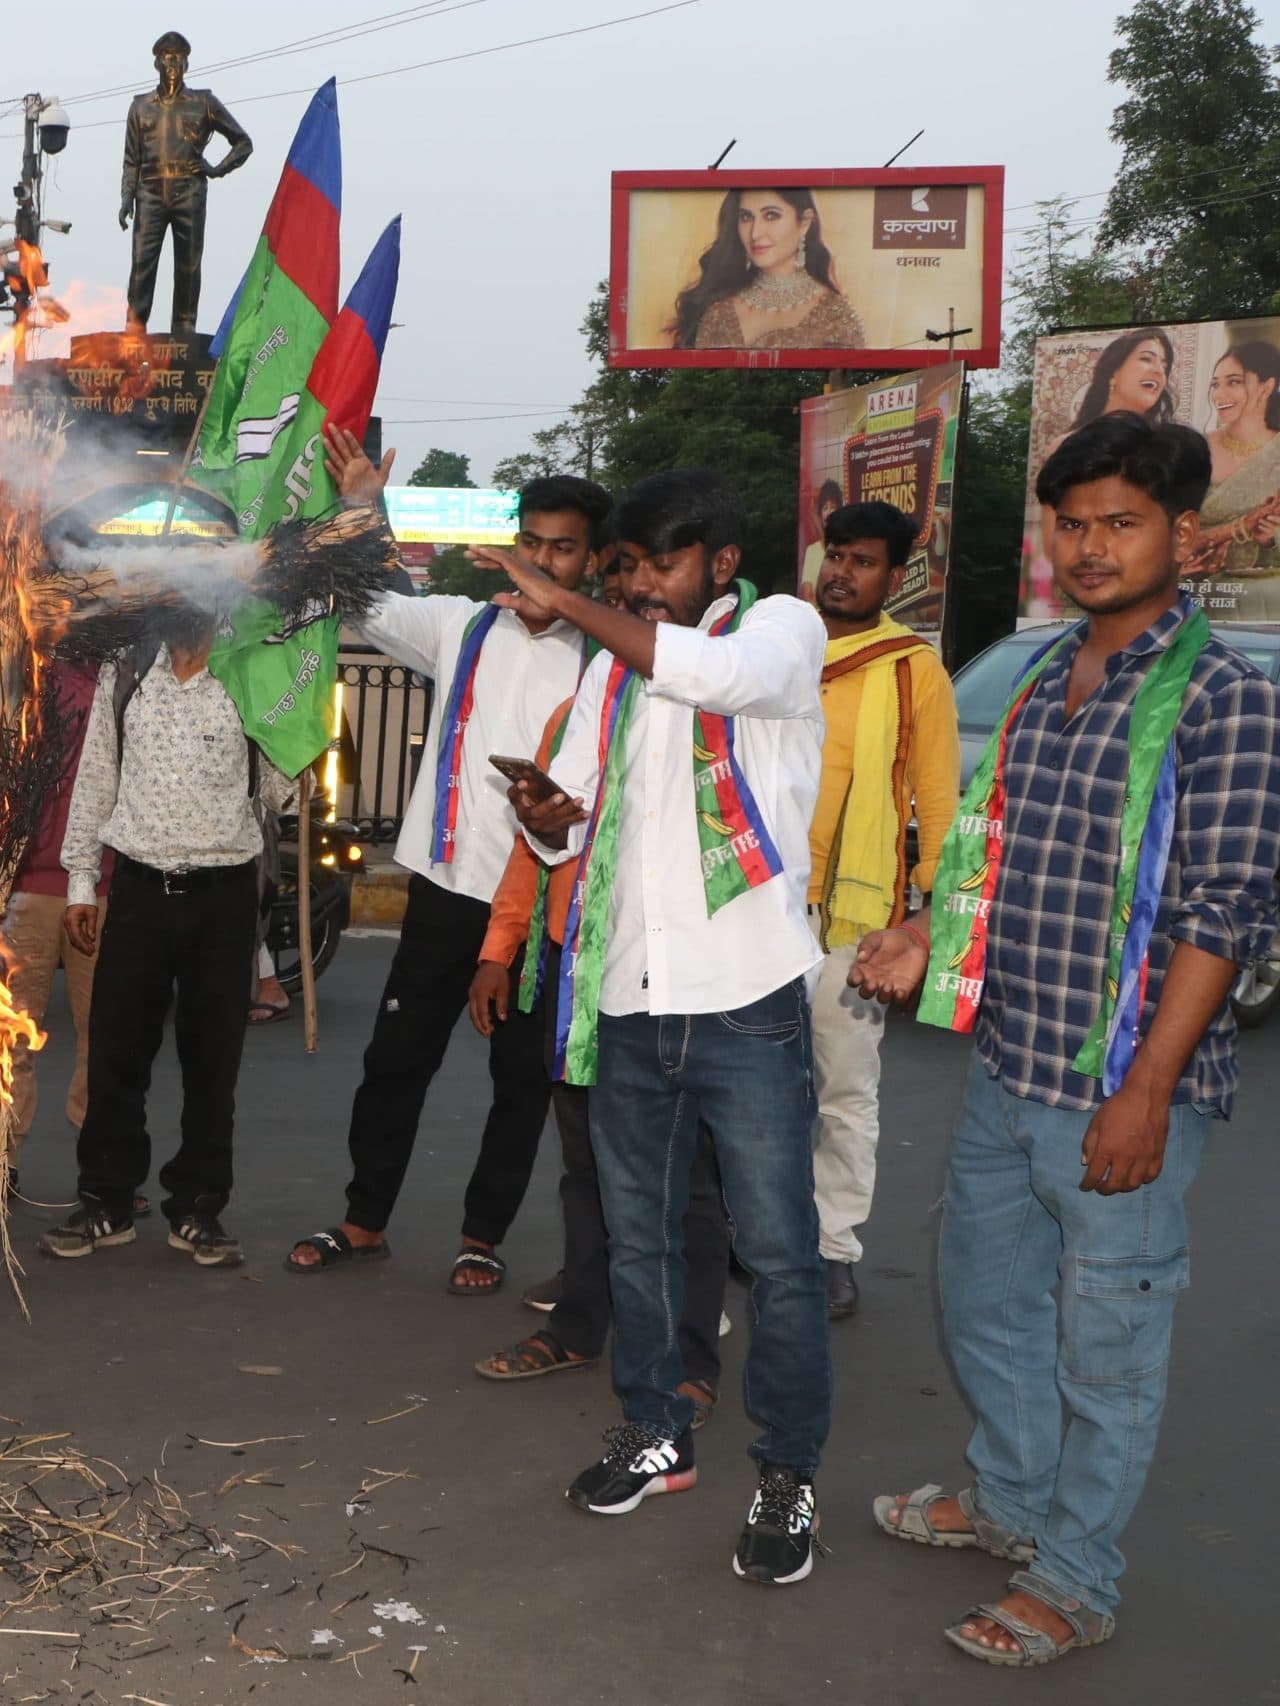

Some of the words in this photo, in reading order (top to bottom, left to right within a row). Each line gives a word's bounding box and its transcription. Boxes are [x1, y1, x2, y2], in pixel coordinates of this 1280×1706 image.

[882, 219, 958, 233] कल्याण
[896, 256, 941, 267] धनबाद
[67, 362, 125, 388] रणधीर
[174, 393, 197, 413] तिथि
[869, 387, 914, 413] ARENA
[861, 472, 882, 489] LEARN
[882, 468, 902, 486] FROM
[903, 463, 918, 482] THE
[1198, 579, 1213, 593] हो
